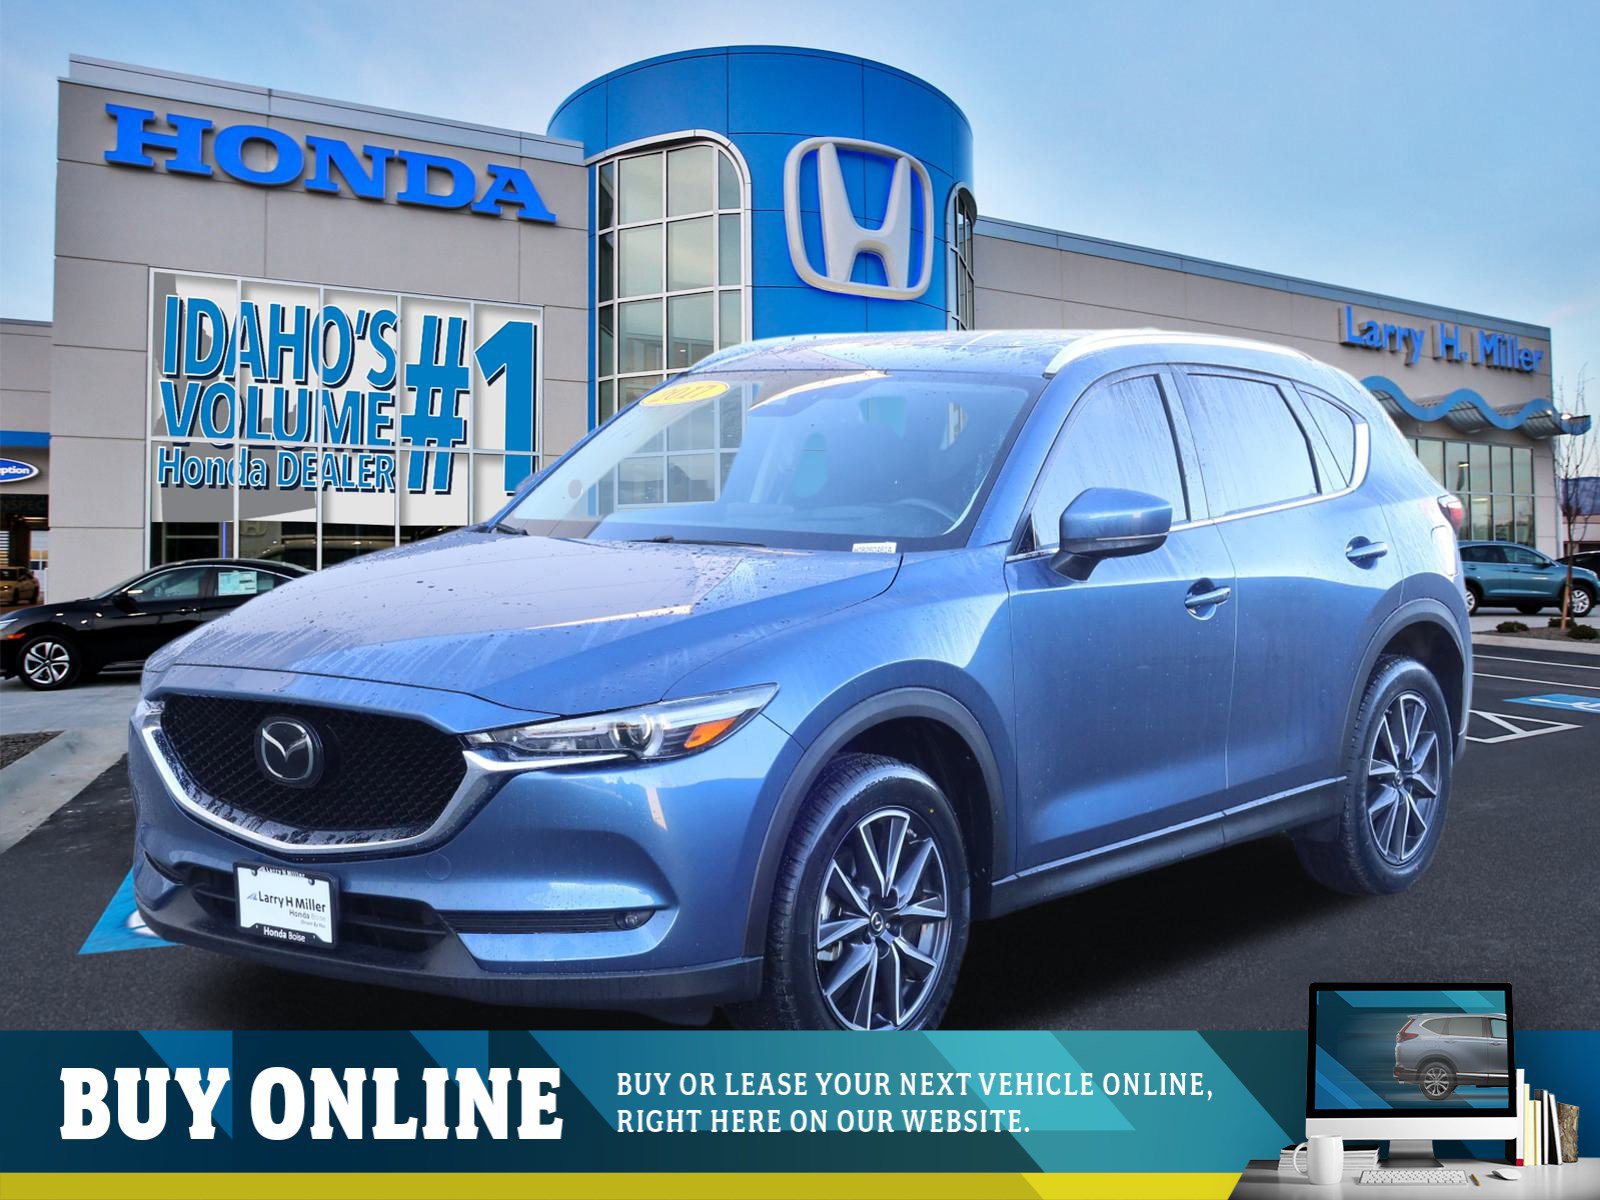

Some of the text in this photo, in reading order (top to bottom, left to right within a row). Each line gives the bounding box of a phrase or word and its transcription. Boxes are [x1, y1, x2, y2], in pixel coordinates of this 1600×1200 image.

[105, 103, 557, 223] HONDA
[162, 295, 398, 388] IDAHO'S
[1345, 305, 1544, 372] Larry H. Miller
[159, 380, 396, 447] VOLUME
[400, 315, 540, 493] #1
[157, 447, 396, 492] Honda DEALER
[258, 890, 326, 913] Larry H Miller
[263, 925, 306, 943] Honda Boise
